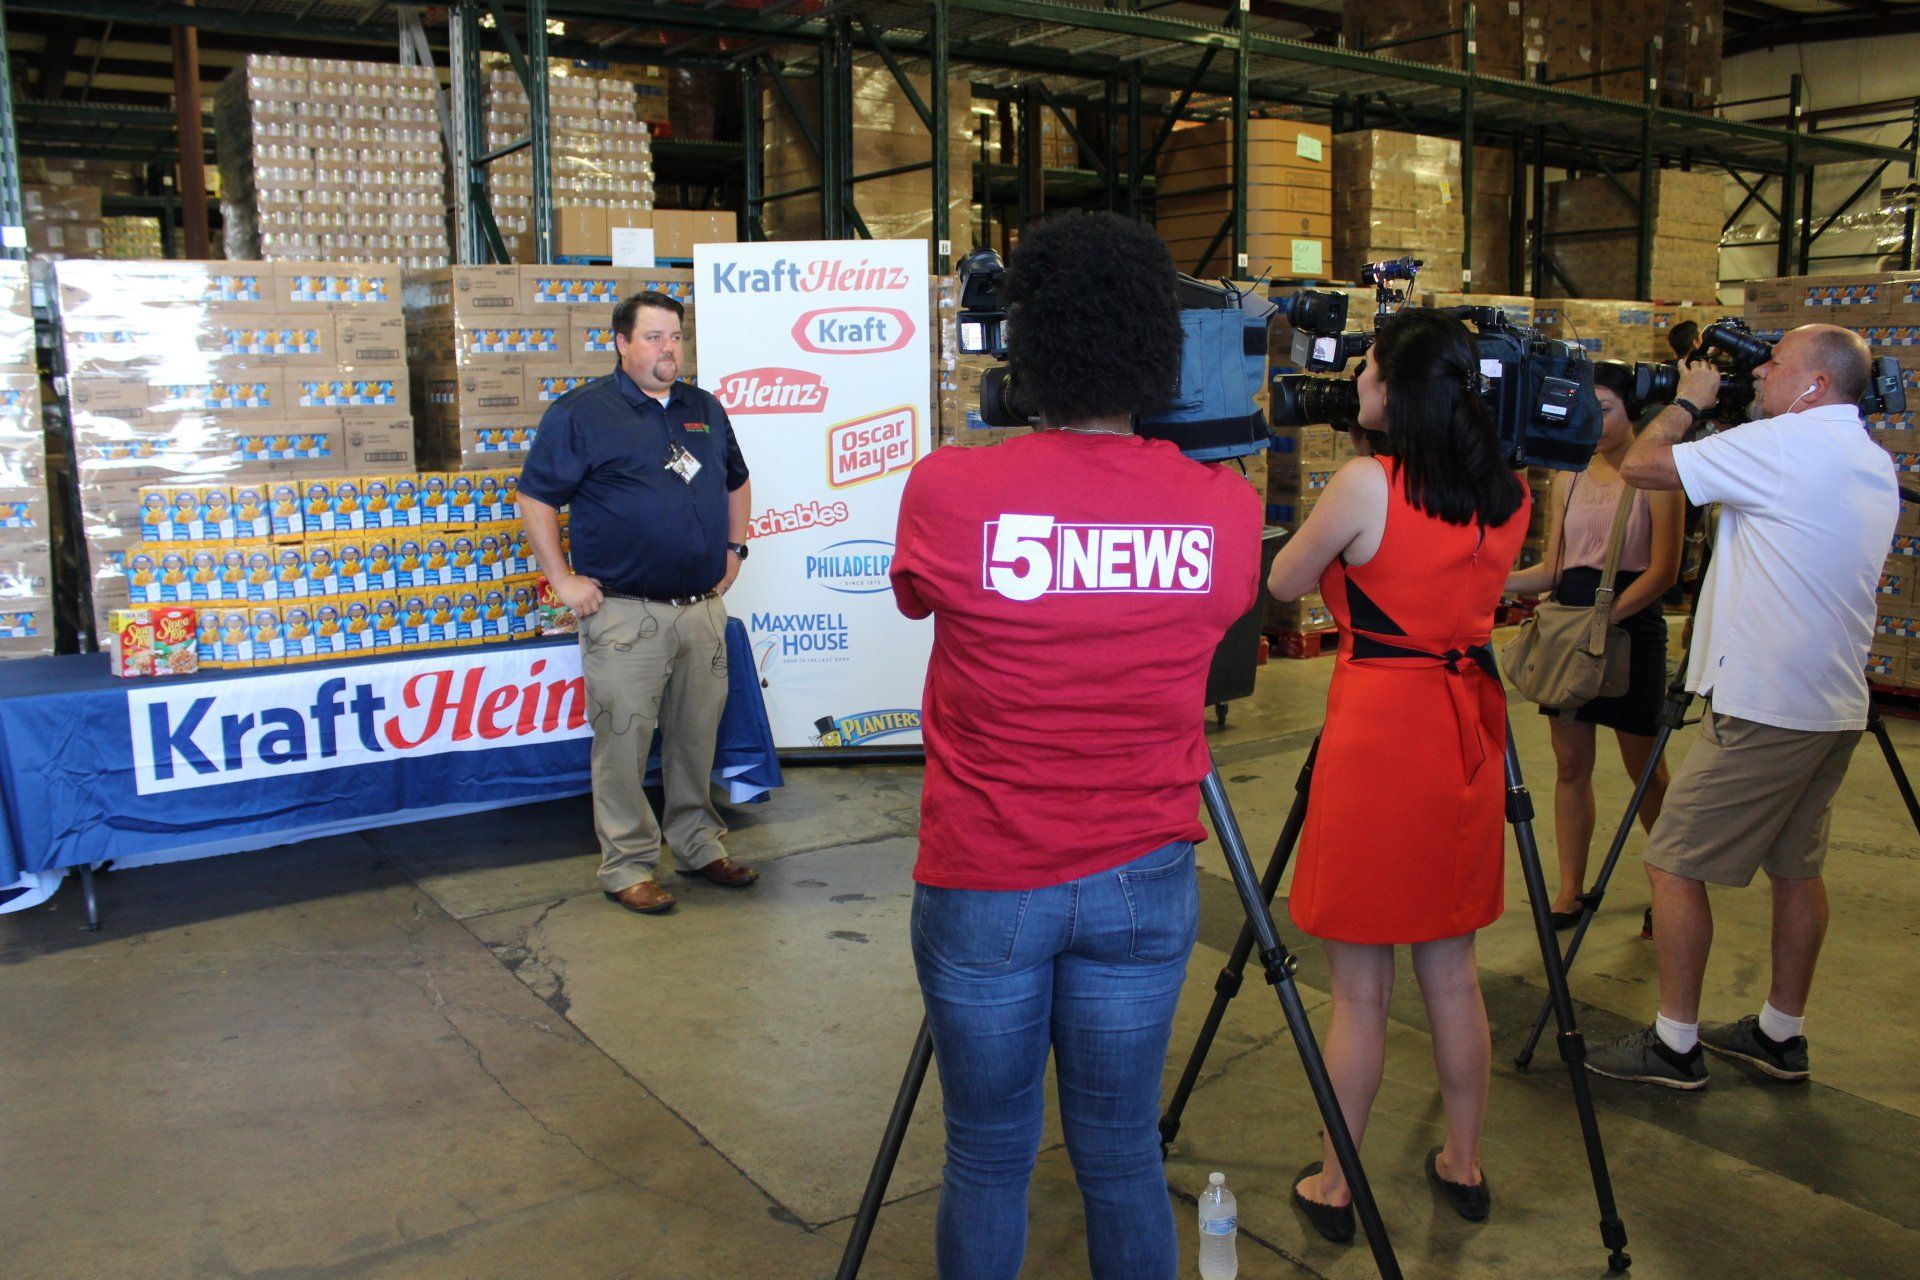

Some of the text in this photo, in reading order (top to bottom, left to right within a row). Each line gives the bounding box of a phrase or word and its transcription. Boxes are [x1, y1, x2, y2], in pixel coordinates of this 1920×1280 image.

[941, 242, 949, 254] B
[819, 317, 886, 343] Kraft
[721, 376, 823, 408] Heinz
[841, 419, 905, 452] Oscar
[838, 438, 909, 478] Mayer
[747, 501, 848, 540] nchables
[806, 554, 892, 580] PHILADELP
[989, 513, 1210, 601] 5 NEWS
[156, 617, 190, 640] Stove
[751, 612, 848, 633] MAXWELL
[170, 629, 186, 643] Top
[783, 633, 848, 656] HOUSE
[841, 712, 920, 740] PLANTERS
